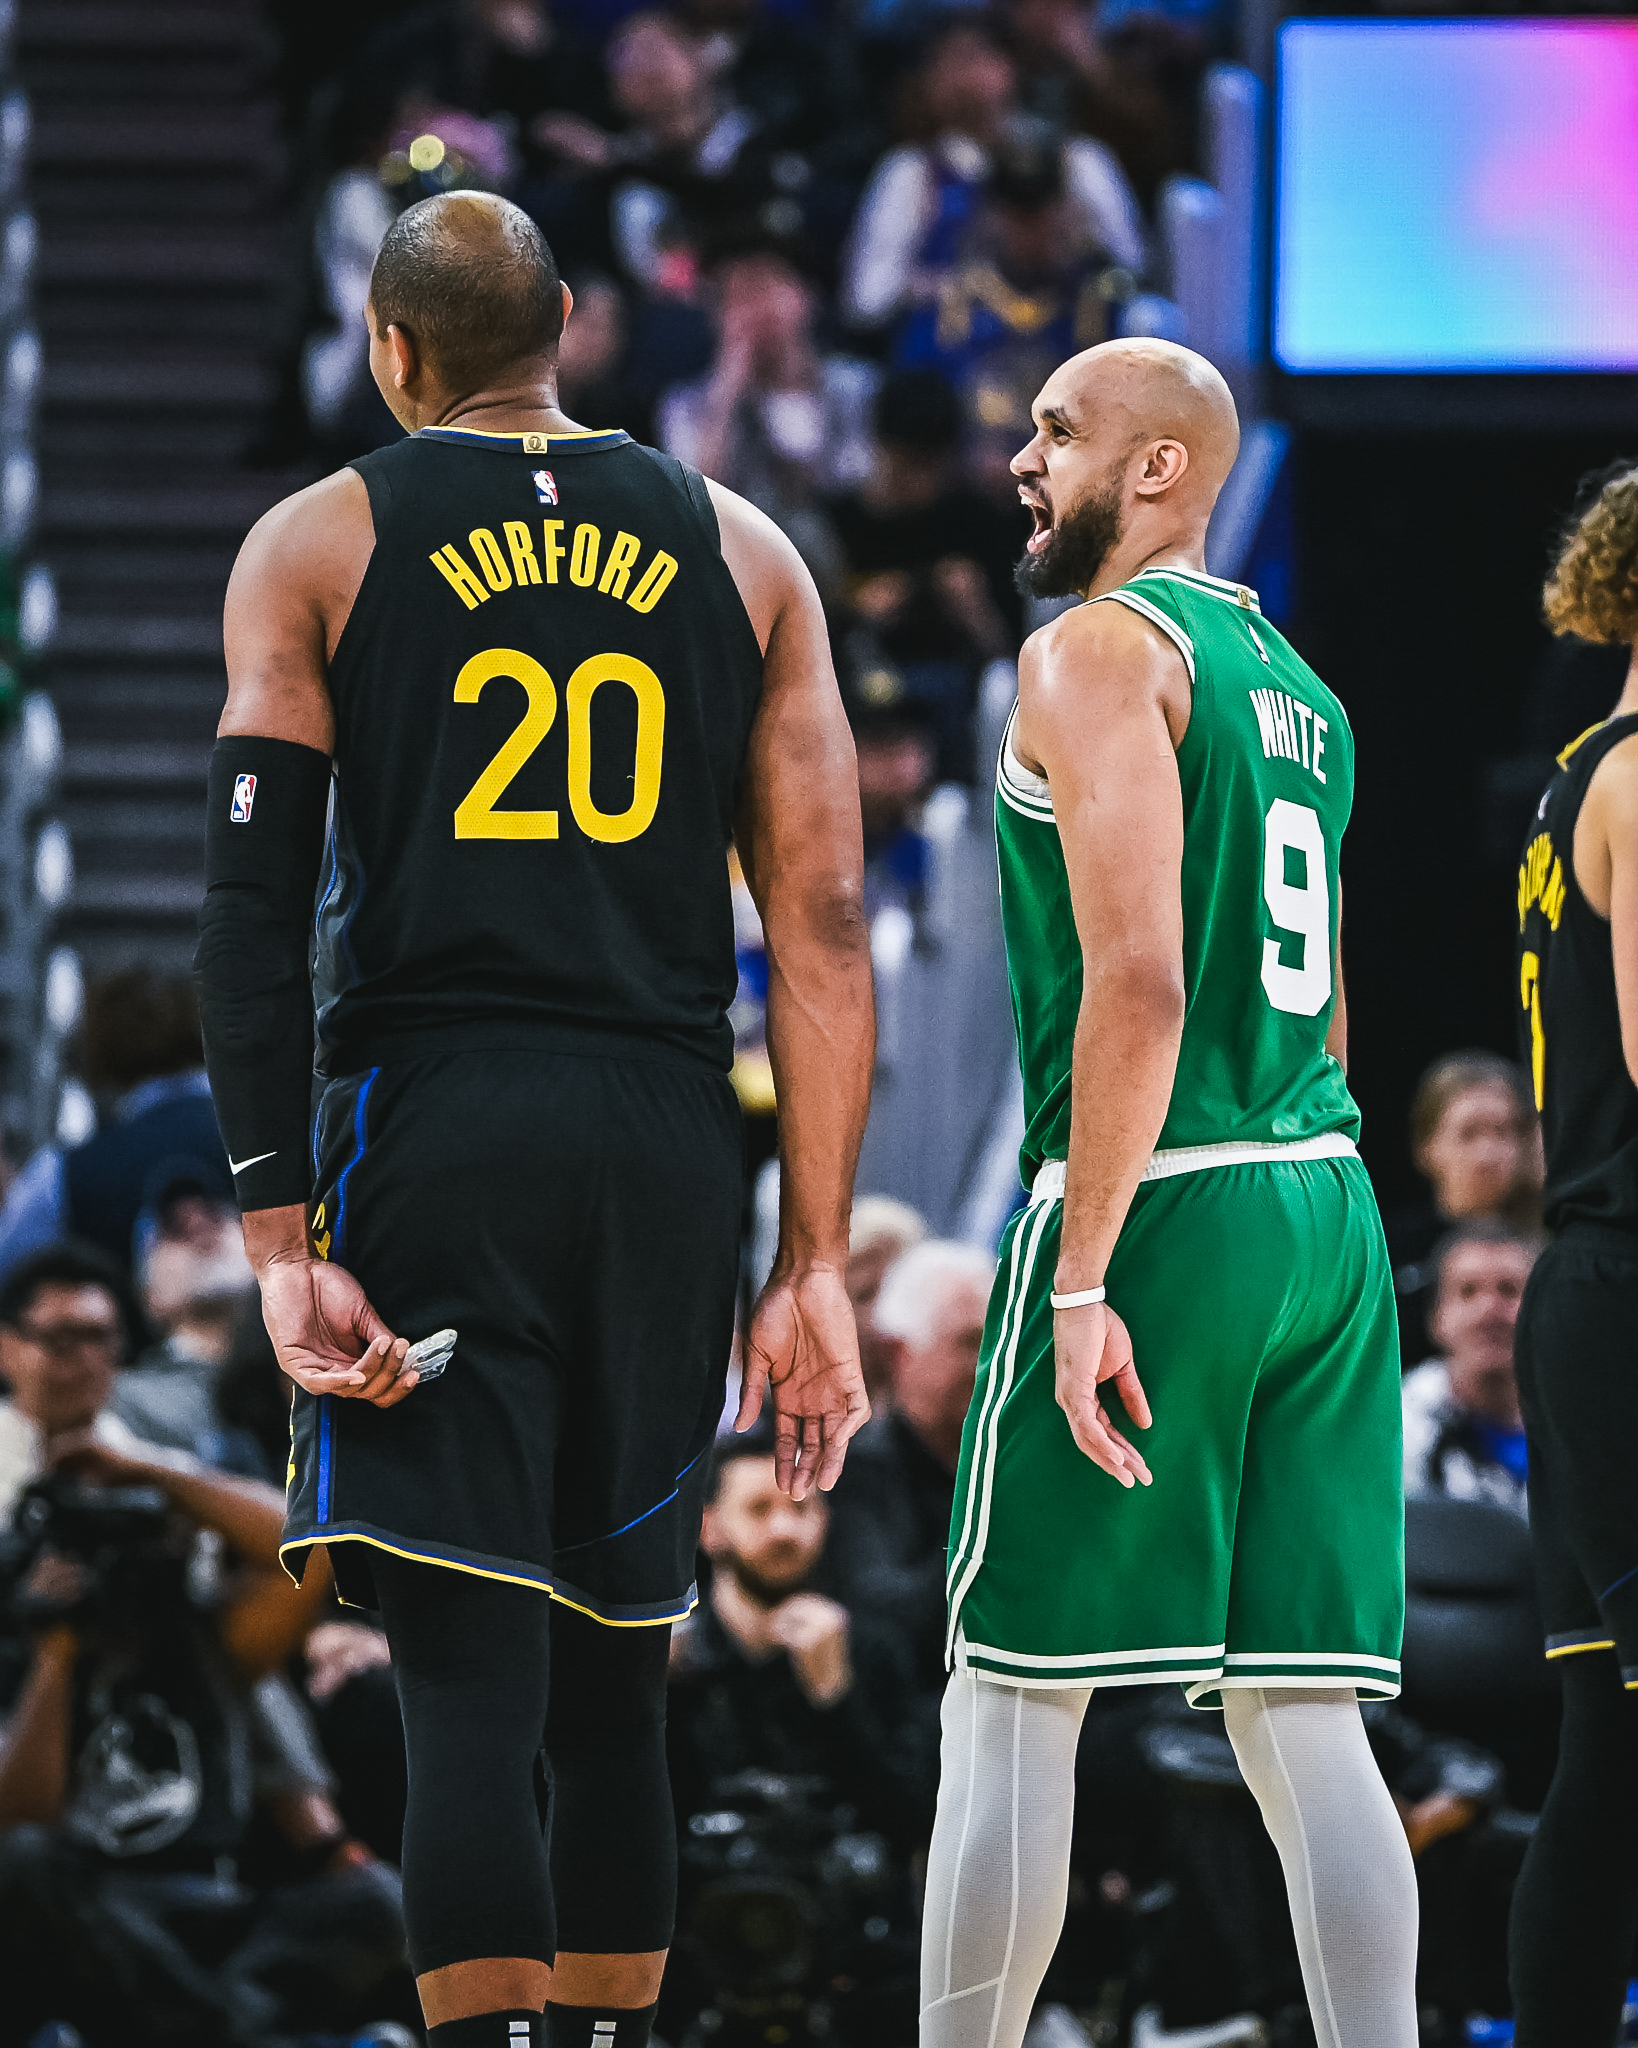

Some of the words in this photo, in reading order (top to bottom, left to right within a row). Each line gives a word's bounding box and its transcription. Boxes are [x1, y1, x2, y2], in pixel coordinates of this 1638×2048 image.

[429, 520, 678, 613] HORFORD
[454, 648, 665, 843] 20
[1249, 688, 1328, 784] WHITE
[1261, 797, 1331, 1017] 9
